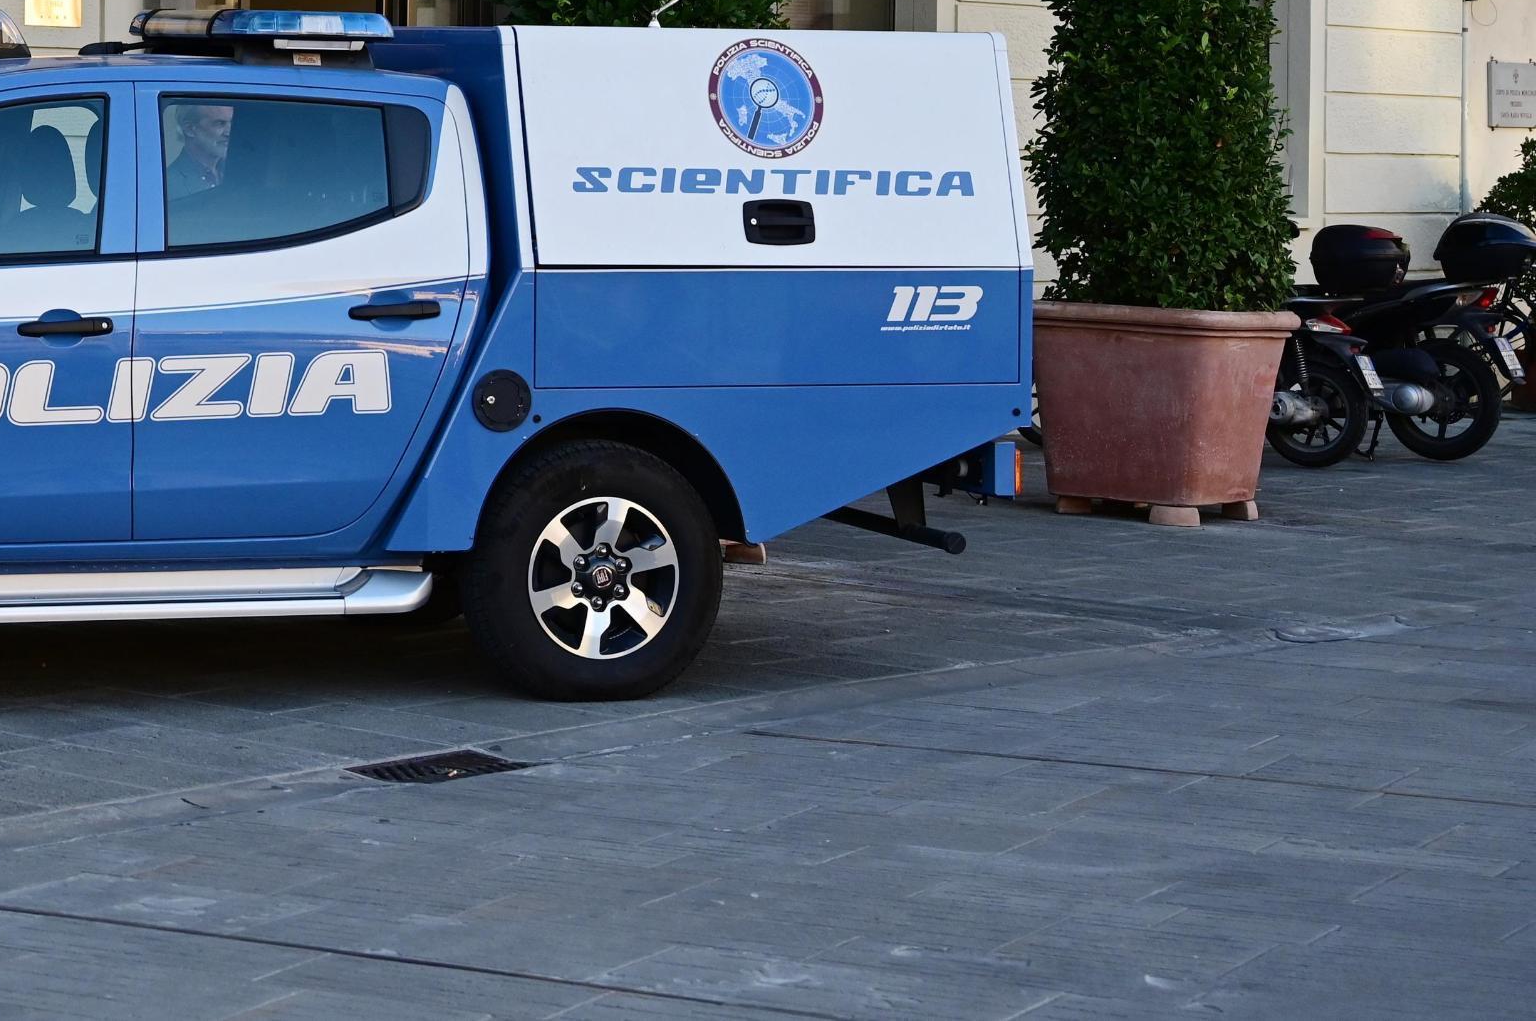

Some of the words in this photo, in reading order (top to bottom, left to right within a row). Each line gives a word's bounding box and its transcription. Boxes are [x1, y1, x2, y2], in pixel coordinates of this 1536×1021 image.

[713, 42, 748, 76] POLIZIA
[749, 39, 814, 79] SCIENTIFICA
[718, 118, 783, 158] SCIENTIFICA
[784, 121, 820, 155] POLIZIA
[572, 167, 976, 197] SCIENTIFICA
[886, 285, 984, 322] 113
